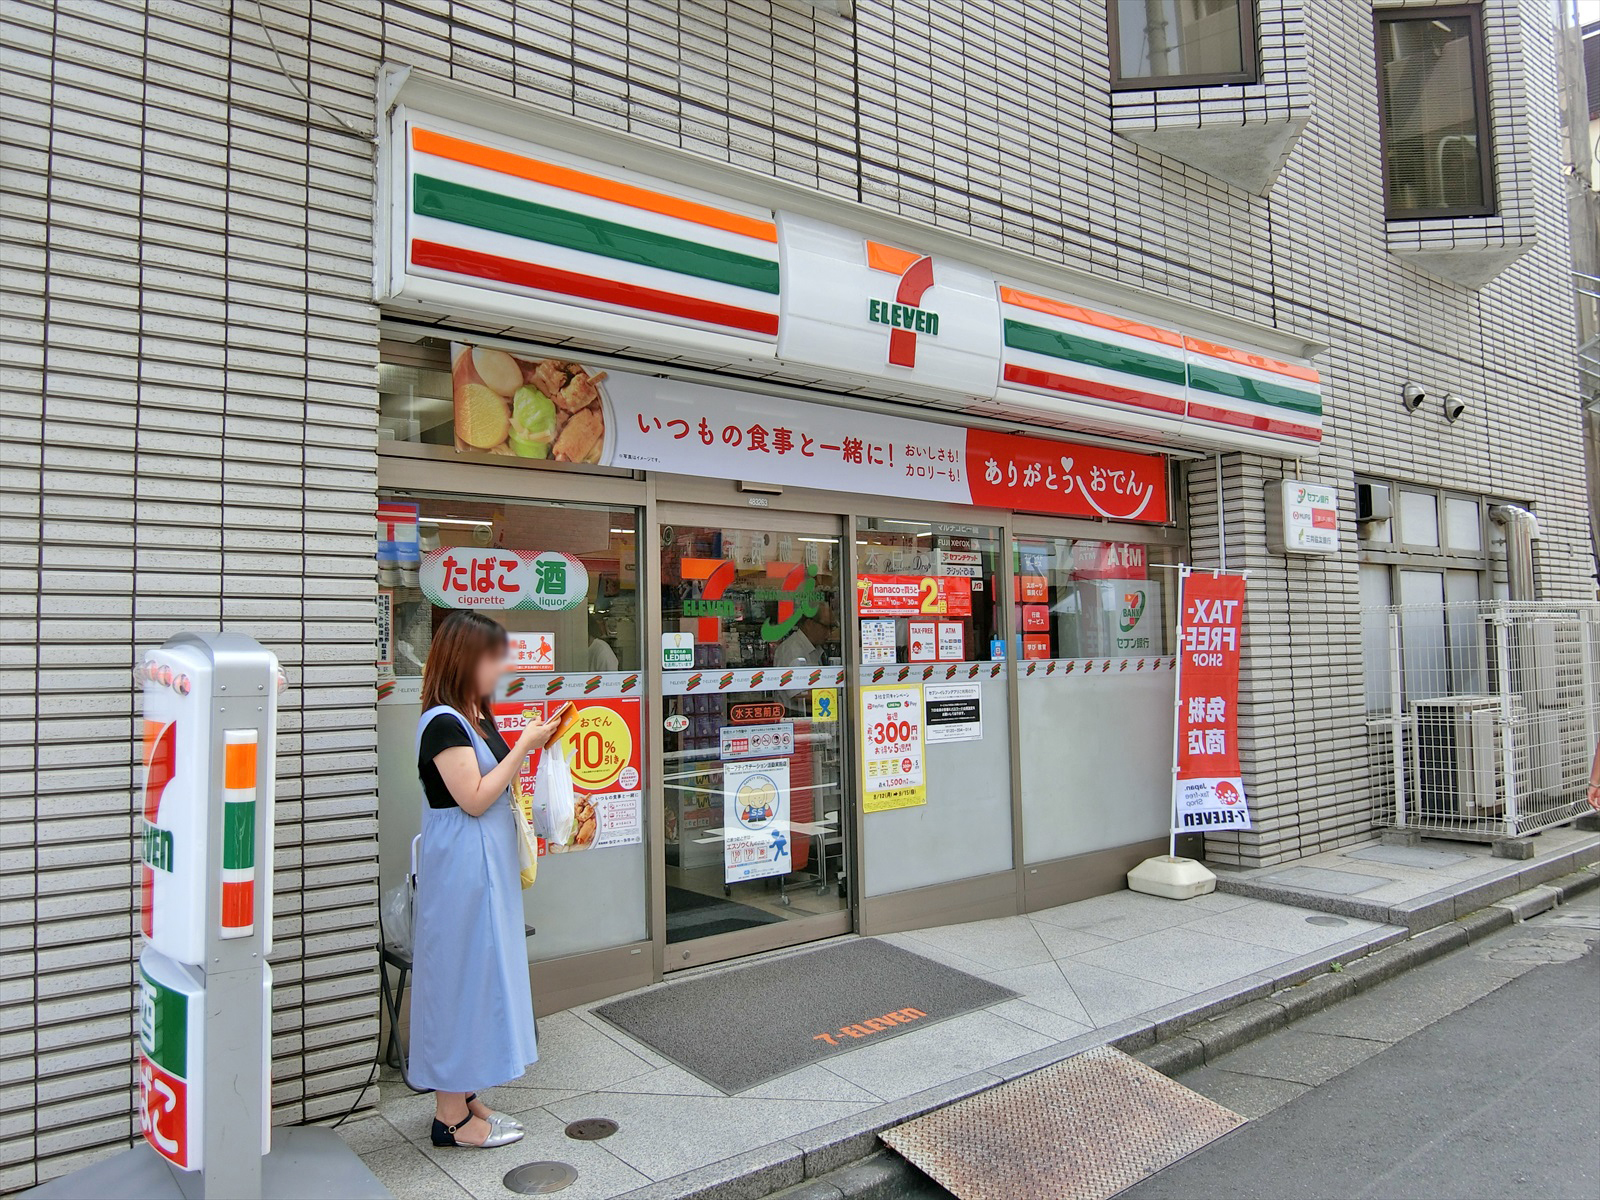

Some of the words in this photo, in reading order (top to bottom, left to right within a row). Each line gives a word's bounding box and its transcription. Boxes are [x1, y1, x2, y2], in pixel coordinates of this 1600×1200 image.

[637, 413, 894, 468] いつもの食事と一緒に!
[905, 444, 959, 463] おいしさも!
[905, 464, 961, 482] カロリーも!
[1090, 465, 1142, 496] おでん
[938, 539, 950, 547] FUJI
[951, 539, 970, 547] xerox
[1107, 546, 1142, 567] ATM
[442, 556, 520, 593] たばこ
[535, 559, 567, 595] 酒
[457, 595, 505, 606] cigarette
[538, 596, 568, 607] liquor
[1122, 608, 1141, 617] BANK
[1117, 637, 1149, 649] セブン銀行
[735, 706, 781, 718] 水天宮前店
[580, 715, 612, 728] おでん
[604, 754, 620, 765] 引き
[751, 808, 764, 817] SS
